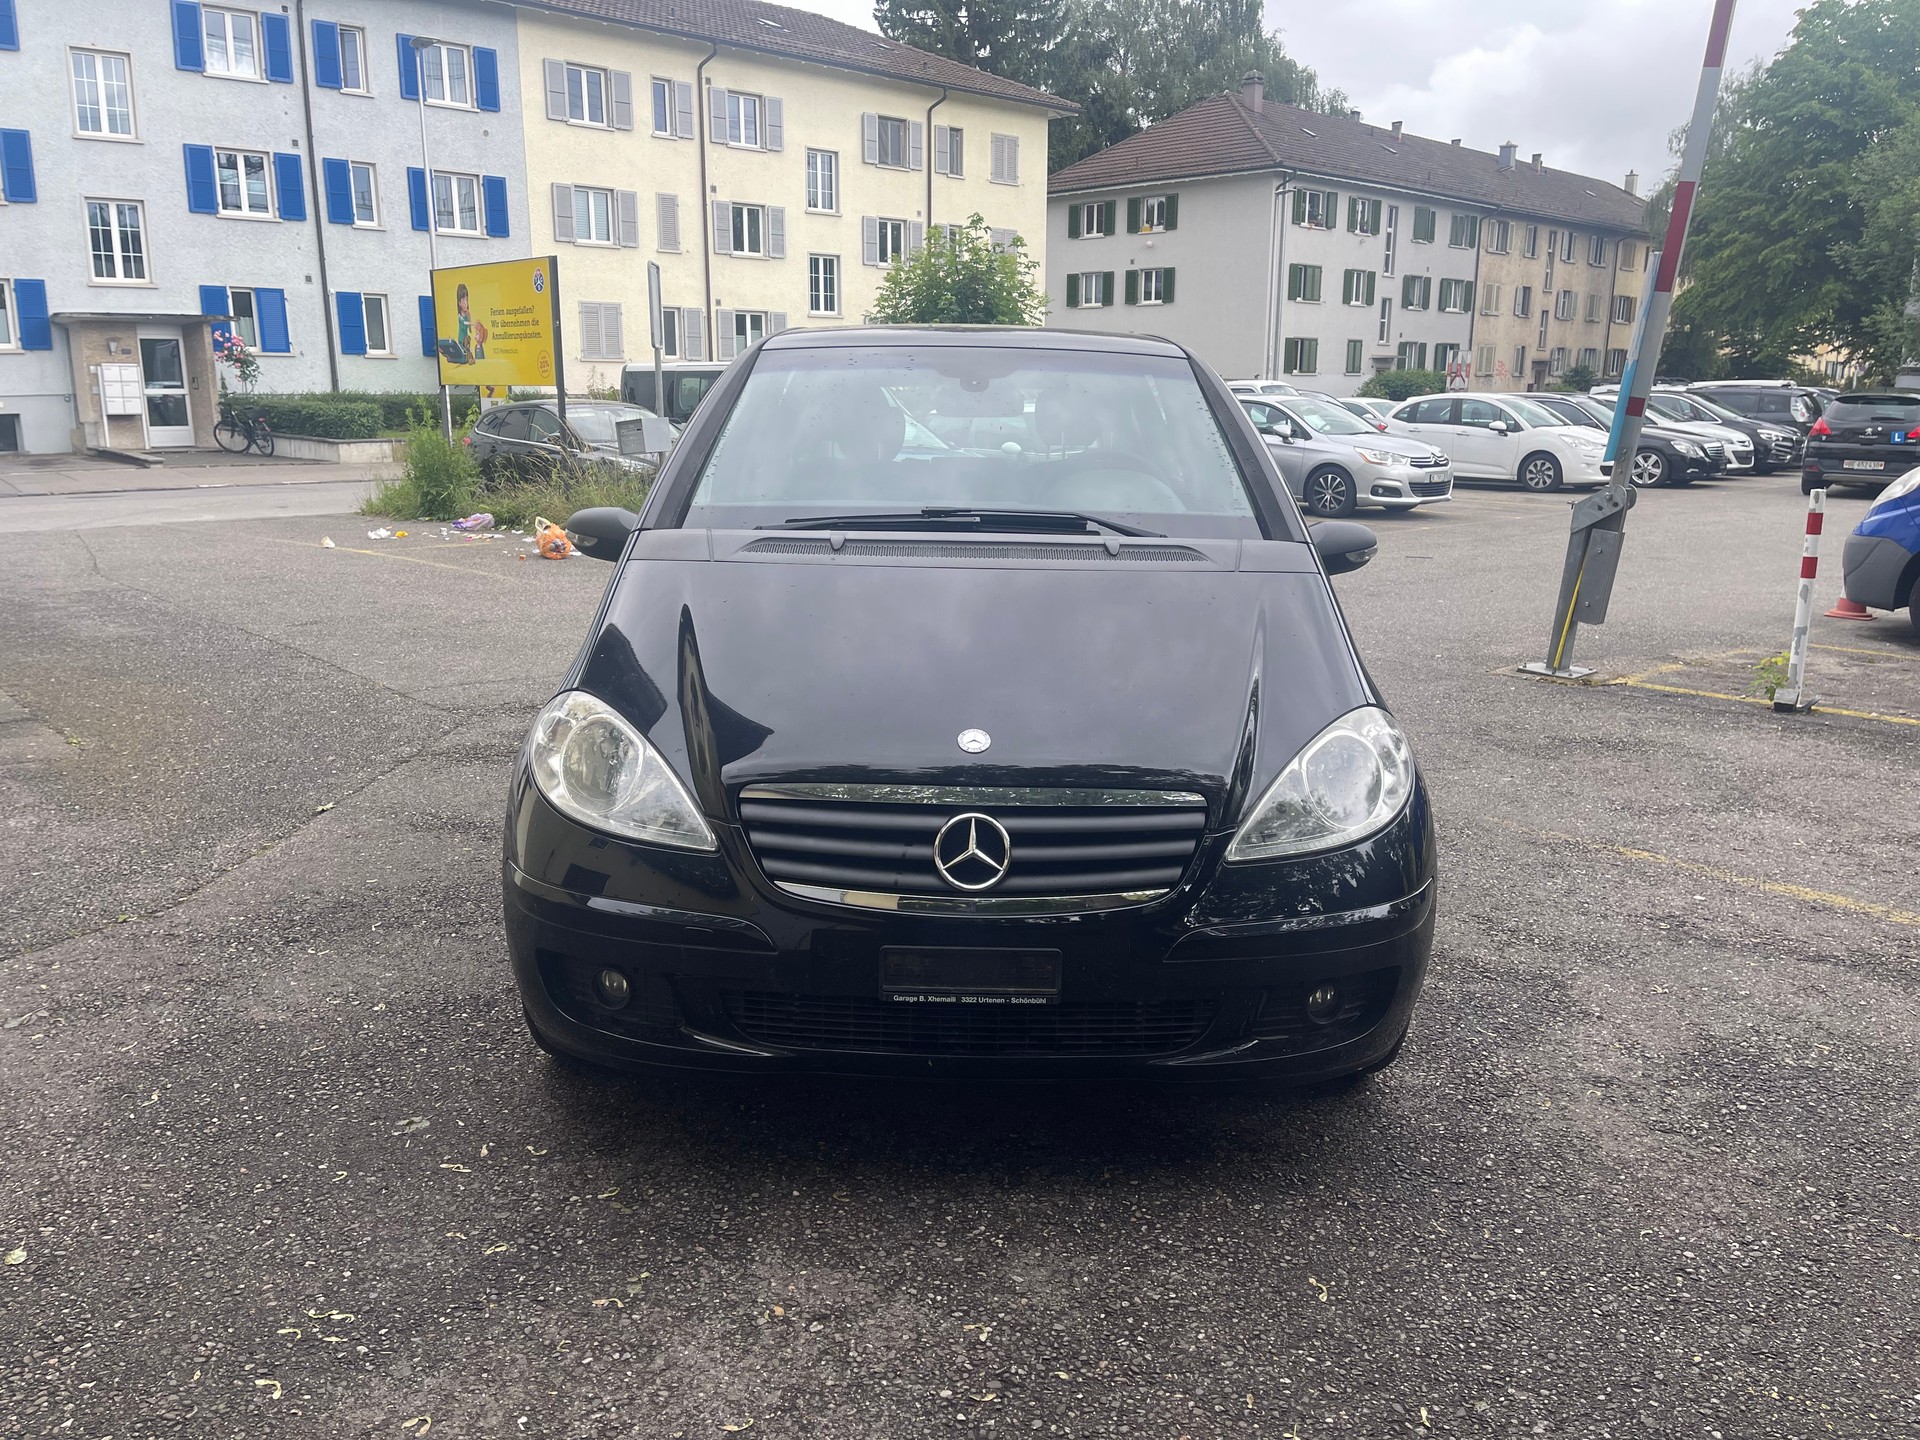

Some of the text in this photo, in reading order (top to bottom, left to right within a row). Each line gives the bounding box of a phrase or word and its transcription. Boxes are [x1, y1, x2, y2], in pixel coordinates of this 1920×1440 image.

[490, 305, 534, 316] Ferien ausgefallen?
[491, 318, 540, 328] Wir übernehmen die
[492, 331, 542, 341] Annullierungskosten.
[1895, 433, 1901, 441] L
[893, 994, 918, 1003] Garage
